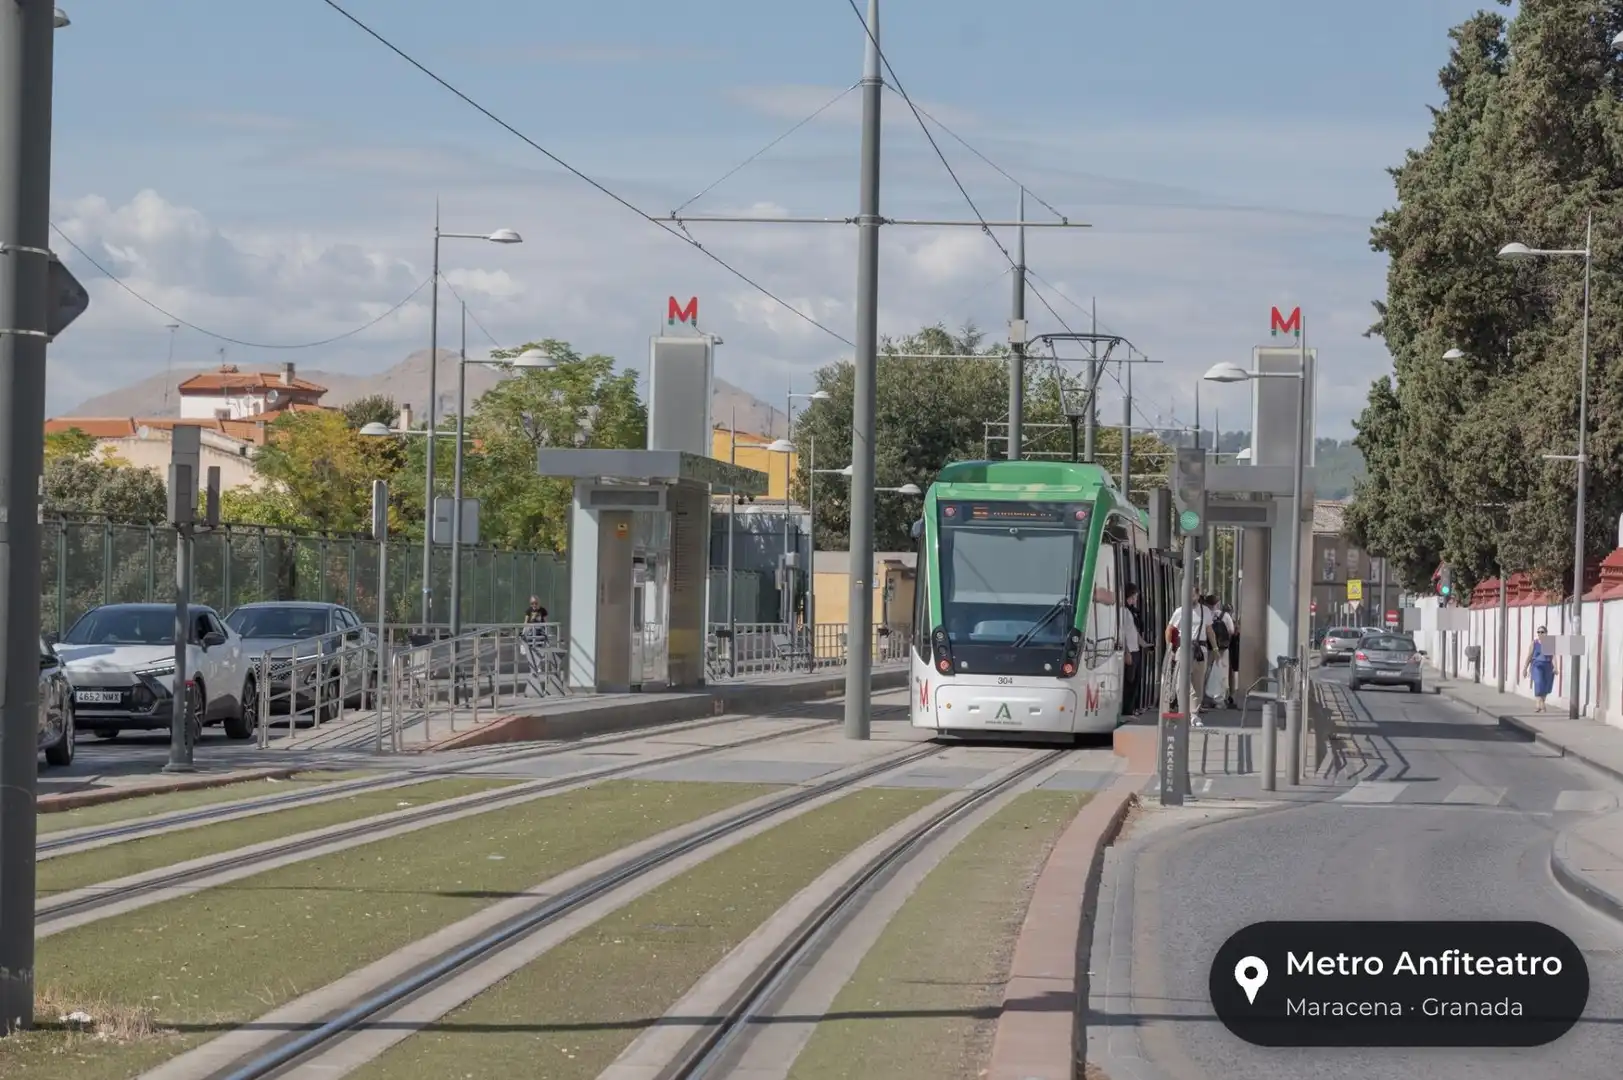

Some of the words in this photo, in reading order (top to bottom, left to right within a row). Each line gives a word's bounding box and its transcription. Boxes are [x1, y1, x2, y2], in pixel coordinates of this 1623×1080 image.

[668, 296, 698, 326] M
[1271, 306, 1301, 337] M
[997, 677, 1013, 685] 304
[78, 692, 101, 702] 4652
[102, 692, 120, 702] NMX
[1084, 683, 1101, 717] M
